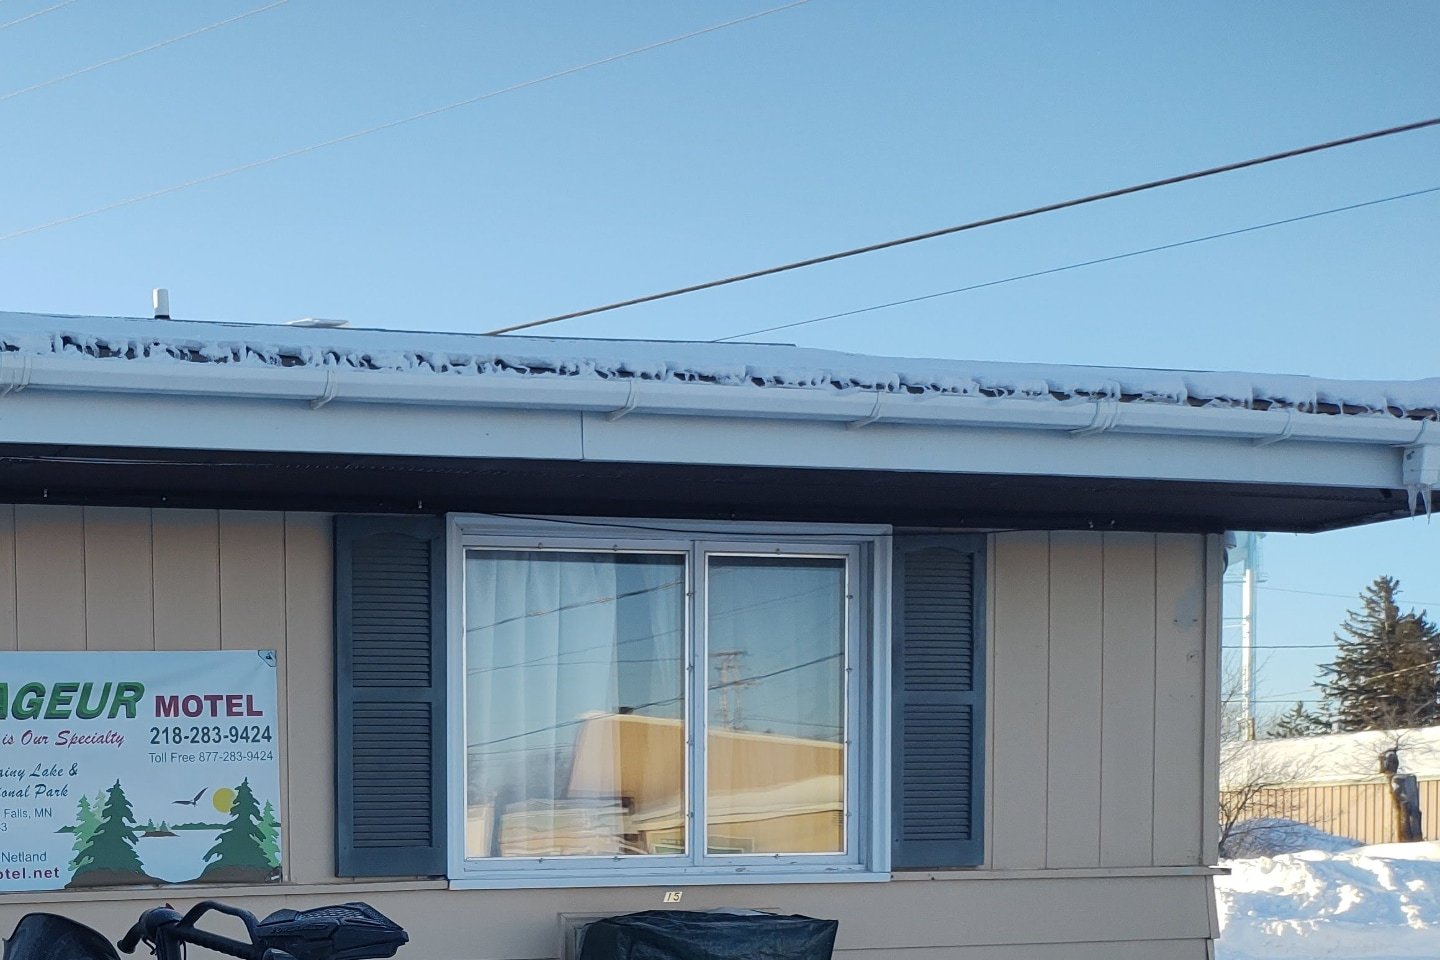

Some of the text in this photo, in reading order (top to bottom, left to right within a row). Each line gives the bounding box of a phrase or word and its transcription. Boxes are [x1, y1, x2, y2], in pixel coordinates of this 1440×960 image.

[155, 694, 263, 718] MOTEL
[2, 732, 15, 745] is
[21, 729, 49, 746] Our
[55, 728, 125, 749] Specialty
[150, 725, 272, 744] 218-283-9424
[148, 750, 273, 763] Toll Free 877-283-9424
[29, 763, 64, 778] Lake
[68, 762, 79, 777] &
[34, 783, 70, 799] Park
[4, 808, 31, 820] Falls,
[34, 807, 53, 818] MN
[1, 851, 47, 863] Netland
[667, 892, 680, 902] 15
